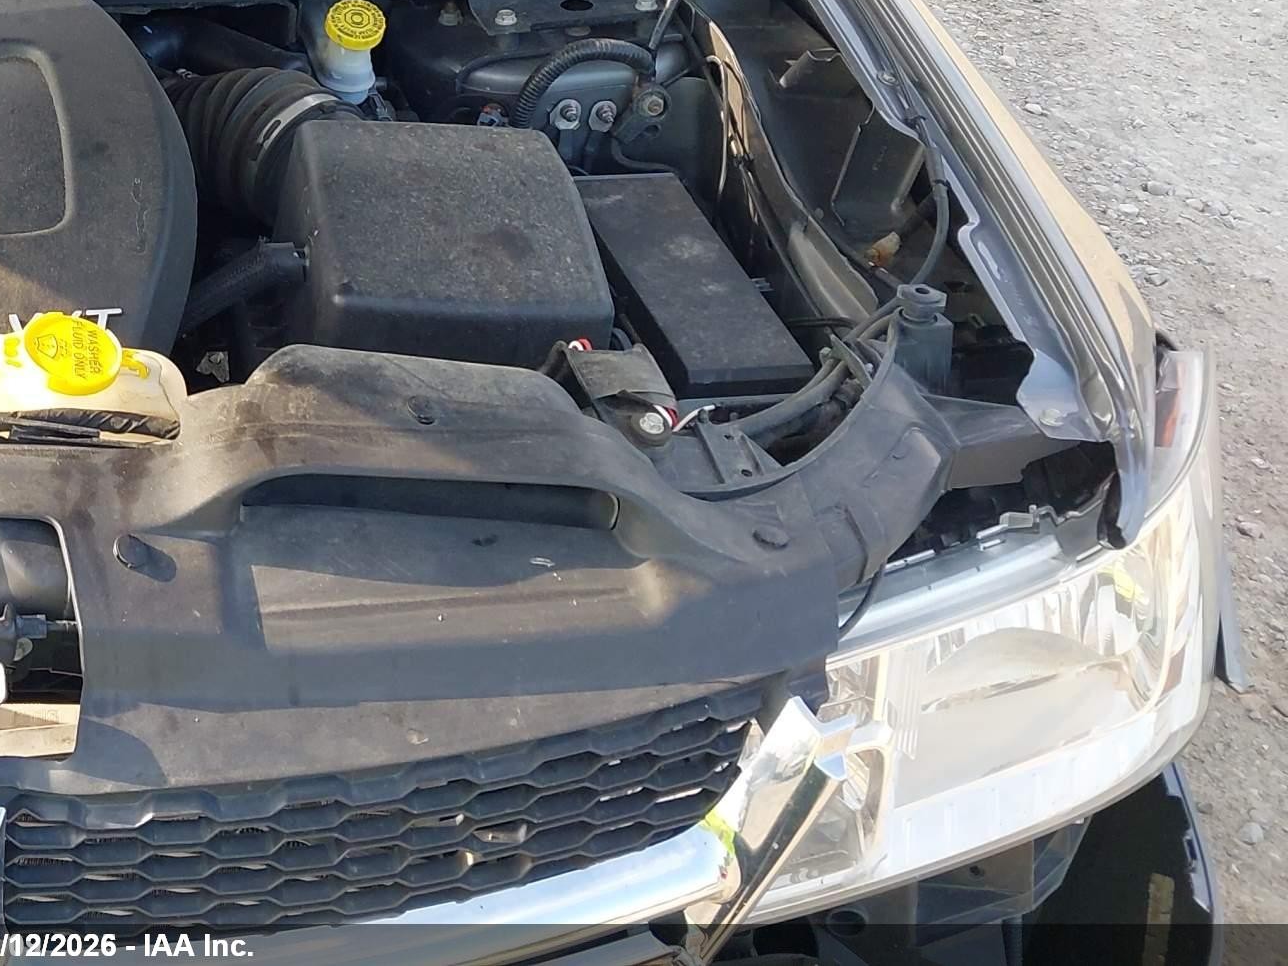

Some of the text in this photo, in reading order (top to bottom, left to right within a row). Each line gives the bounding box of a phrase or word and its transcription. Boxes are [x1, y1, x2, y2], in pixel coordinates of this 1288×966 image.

[72, 319, 87, 381] FLUID ONLY
[86, 329, 103, 375] WASHER
